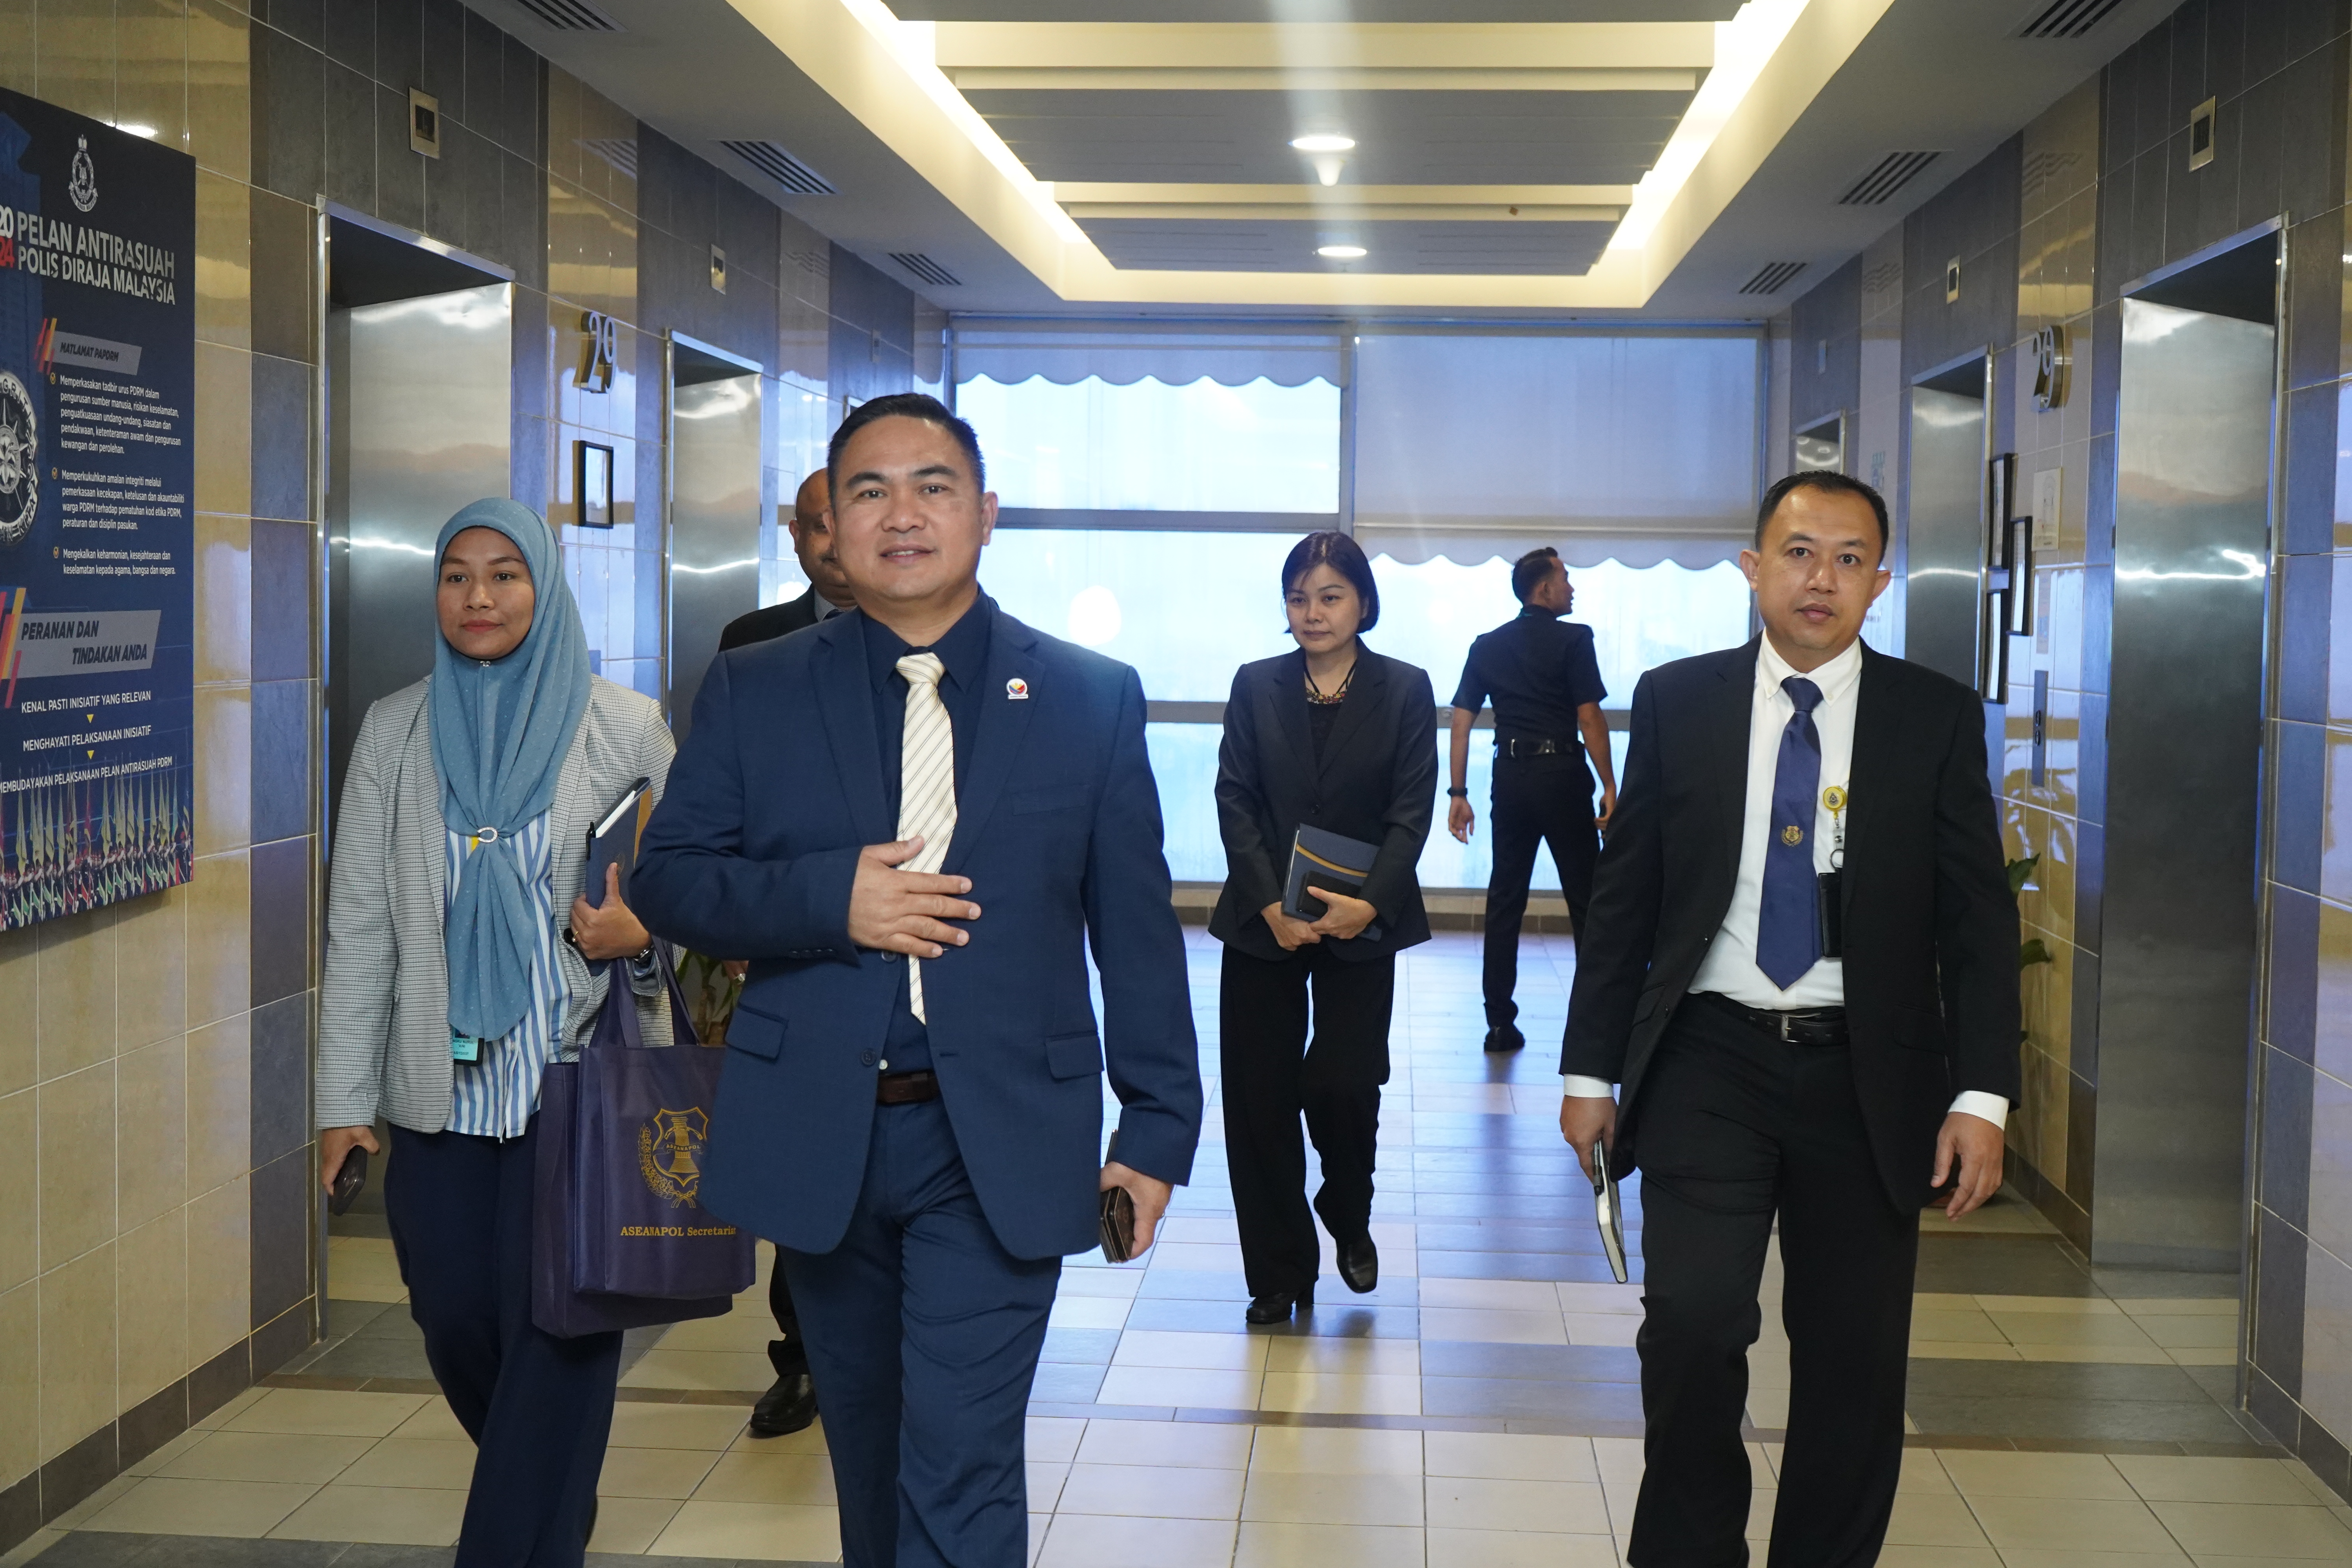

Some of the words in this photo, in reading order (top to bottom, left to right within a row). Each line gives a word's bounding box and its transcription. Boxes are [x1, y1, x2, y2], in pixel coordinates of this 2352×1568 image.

[18, 211, 72, 253] PELAN
[76, 227, 174, 279] ANTIRASUAH
[18, 246, 59, 278] POLIS
[62, 255, 111, 289] DIRAJA
[114, 268, 175, 305] MALAYSIA
[60, 342, 94, 357] MATLAMAT
[587, 311, 617, 394] 29
[2031, 326, 2055, 412] 29
[60, 375, 102, 390] Memperkasakan
[102, 382, 117, 392] tadbir
[118, 386, 129, 394] urus
[130, 386, 144, 396] PDRM
[145, 388, 159, 399] dalam
[61, 392, 91, 403] pengurusan
[92, 396, 110, 406] sumber
[111, 400, 132, 411] manusia,
[133, 402, 149, 412] risikan
[150, 403, 179, 418] keselamatan,
[61, 408, 102, 421] penguatkuasaan
[103, 412, 142, 428] undang-undang,
[143, 418, 162, 428] siasatan
[162, 421, 171, 430] dan
[61, 423, 94, 437] pendakwaan,
[96, 426, 129, 439] ketenteraman
[130, 432, 144, 441] awam
[145, 433, 154, 443] dan
[155, 436, 181, 446] pengurusan
[61, 438, 87, 452] kewangan
[89, 441, 98, 451] dan
[99, 443, 124, 454] perolehan.
[62, 470, 106, 483] Memperkukuhkan
[107, 474, 124, 484] amalan
[125, 475, 144, 486] integriti
[145, 477, 162, 487] melalui
[62, 487, 96, 497] pemerkasaan
[97, 488, 124, 501] kecekapan,
[125, 490, 147, 501] ketelusan
[148, 492, 156, 502] dan
[157, 493, 184, 503] akauntabiliti
[62, 503, 78, 514] warga
[79, 503, 94, 512] PDRM
[96, 504, 118, 515] terhadap
[118, 506, 145, 516] pematuhan
[145, 506, 154, 516] kod
[155, 507, 166, 517] etika
[167, 508, 182, 519] PDRM,
[63, 518, 87, 529] peraturan
[89, 518, 98, 528] dan
[99, 519, 116, 530] disiplin
[117, 520, 138, 531] pasukan.
[63, 548, 96, 561] Mengekalkan
[97, 549, 129, 561] keharmonian,
[130, 550, 161, 561] kesejahteraan
[162, 550, 171, 560] dan
[64, 564, 95, 575] keselamatan
[96, 564, 114, 577] kepada
[115, 566, 132, 577] agama,
[132, 565, 149, 577] bangsa
[150, 565, 158, 575] dan
[159, 566, 176, 577] negara.
[21, 621, 75, 640] PERANAN
[76, 620, 100, 639] DAN
[72, 645, 120, 665] TINDAKAN
[121, 644, 147, 661] ANDA
[22, 700, 47, 713] KENAL
[49, 699, 68, 711] PASTI
[70, 695, 100, 709] INISIATIF
[102, 693, 120, 705] YANG
[122, 690, 151, 703] RELEVAN
[23, 735, 70, 751] MENGHAYATI
[72, 729, 122, 745] PELAKSANAAN
[123, 725, 152, 739] INISIATIF
[54, 768, 100, 784] PELAKSANAAN
[101, 766, 119, 777] PELAN
[121, 759, 156, 775] ANTIRASUAH
[157, 756, 172, 768] PDRM
[621, 1227, 684, 1236] ASEANAPOL
[688, 1226, 736, 1236] Secretariat
